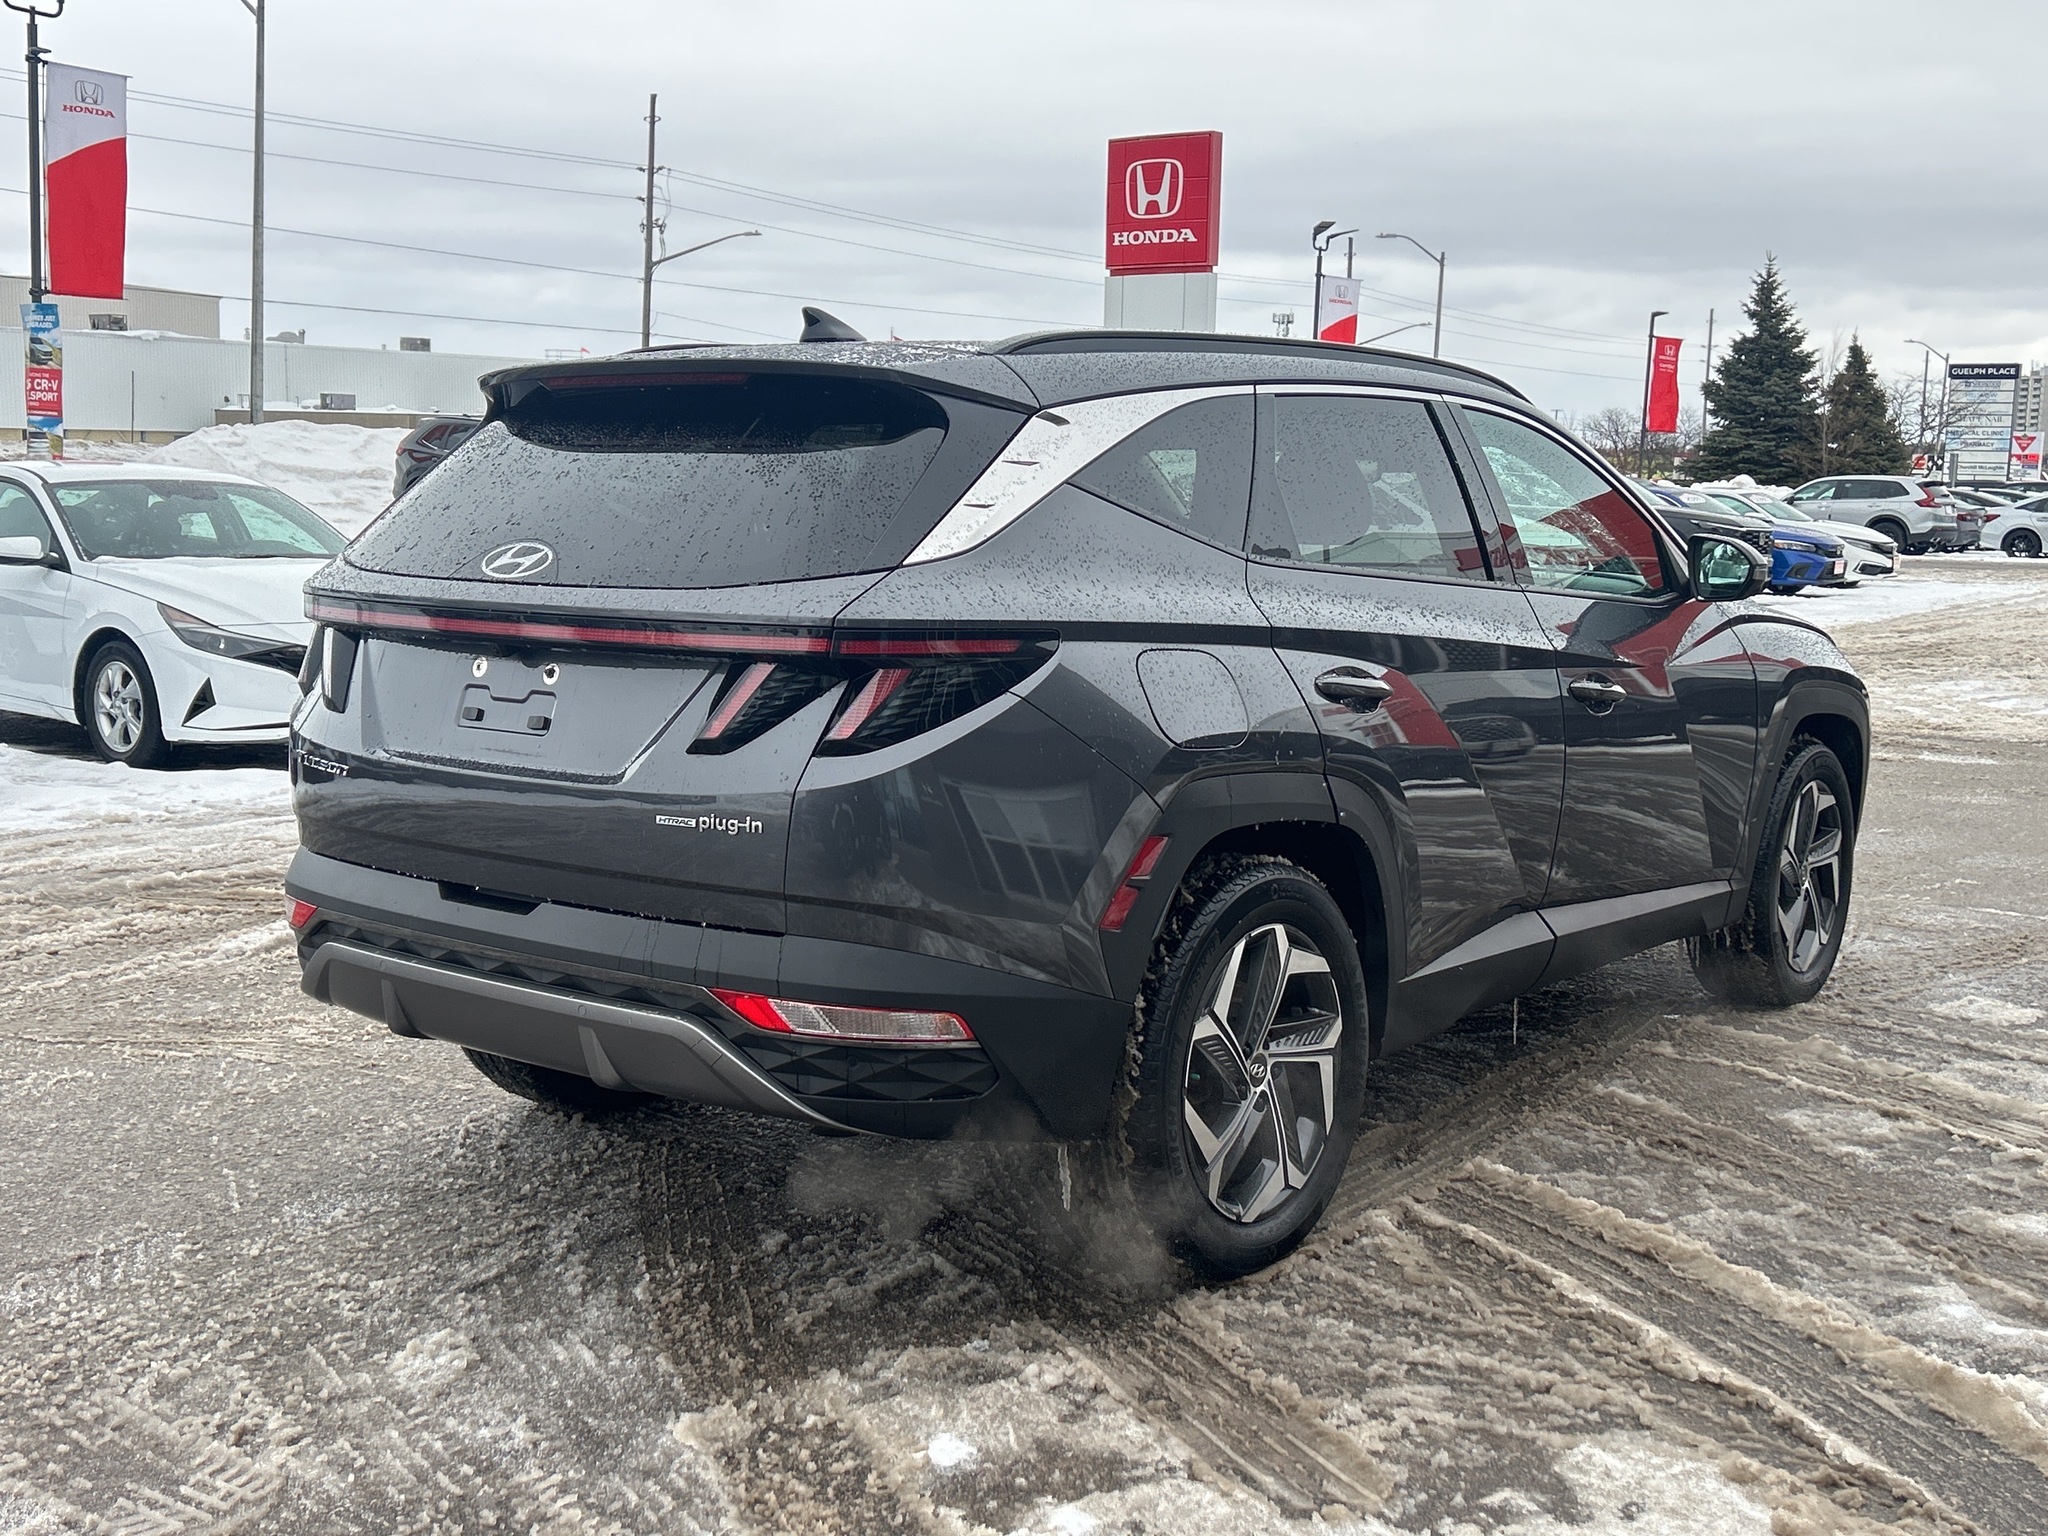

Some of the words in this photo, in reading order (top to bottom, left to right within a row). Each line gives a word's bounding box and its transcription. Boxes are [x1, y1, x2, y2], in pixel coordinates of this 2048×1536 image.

[62, 104, 116, 118] HONDA
[1112, 228, 1198, 246] HONDA
[1951, 367, 1986, 375] GUELPH
[1987, 367, 2016, 375] PLACE
[33, 379, 58, 391] CR-V
[656, 816, 697, 827] HTRAC
[699, 813, 763, 835] plug-in
